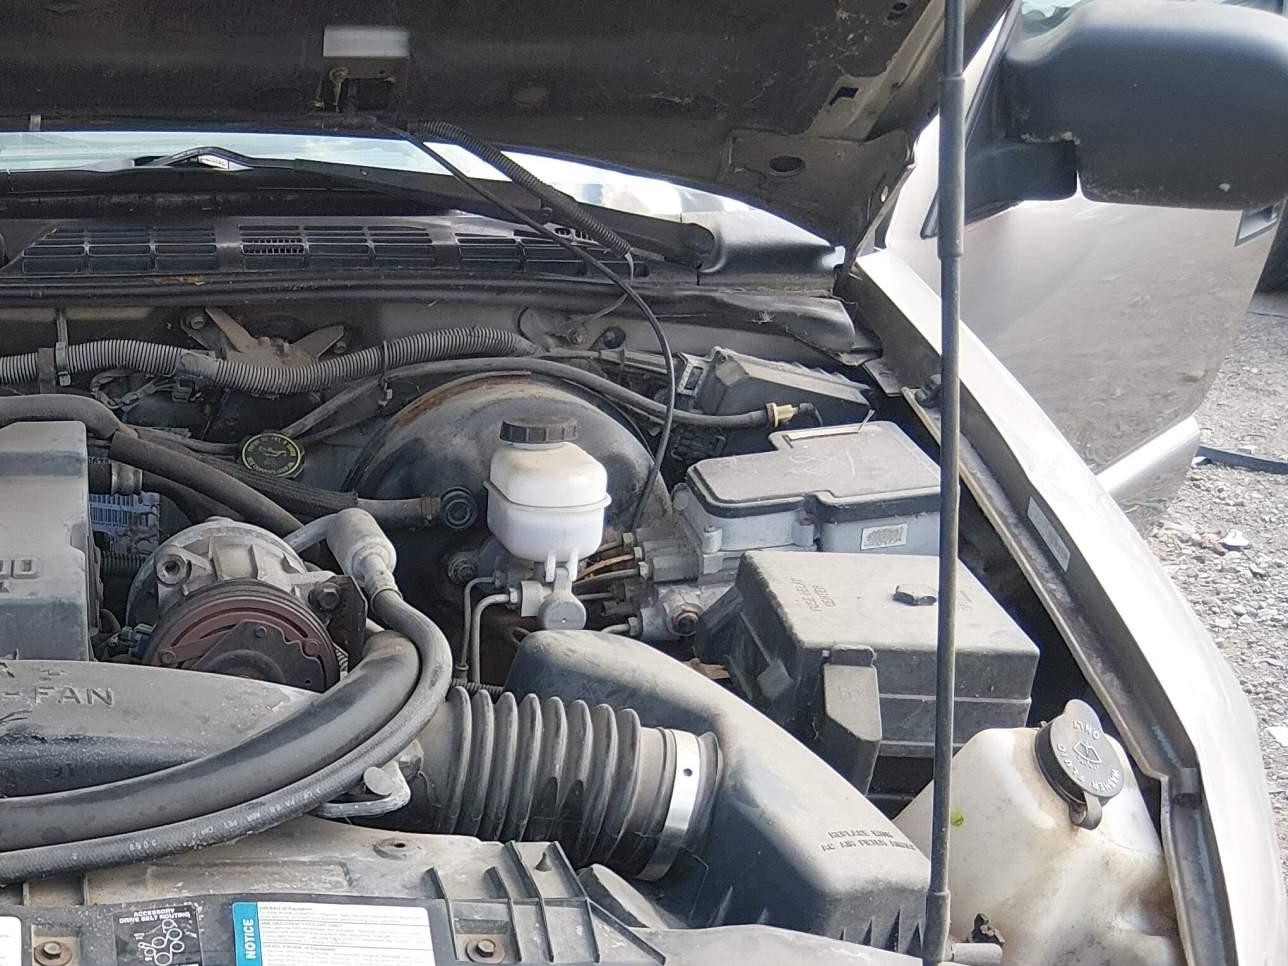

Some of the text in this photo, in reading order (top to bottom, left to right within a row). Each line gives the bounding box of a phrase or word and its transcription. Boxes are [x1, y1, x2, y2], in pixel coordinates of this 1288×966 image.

[1073, 720, 1100, 740] ONLY
[1092, 768, 1120, 793] WASHER
[134, 908, 175, 917] ACCESSORY
[159, 911, 191, 920] ROUTING
[243, 918, 257, 961] NOTICE
